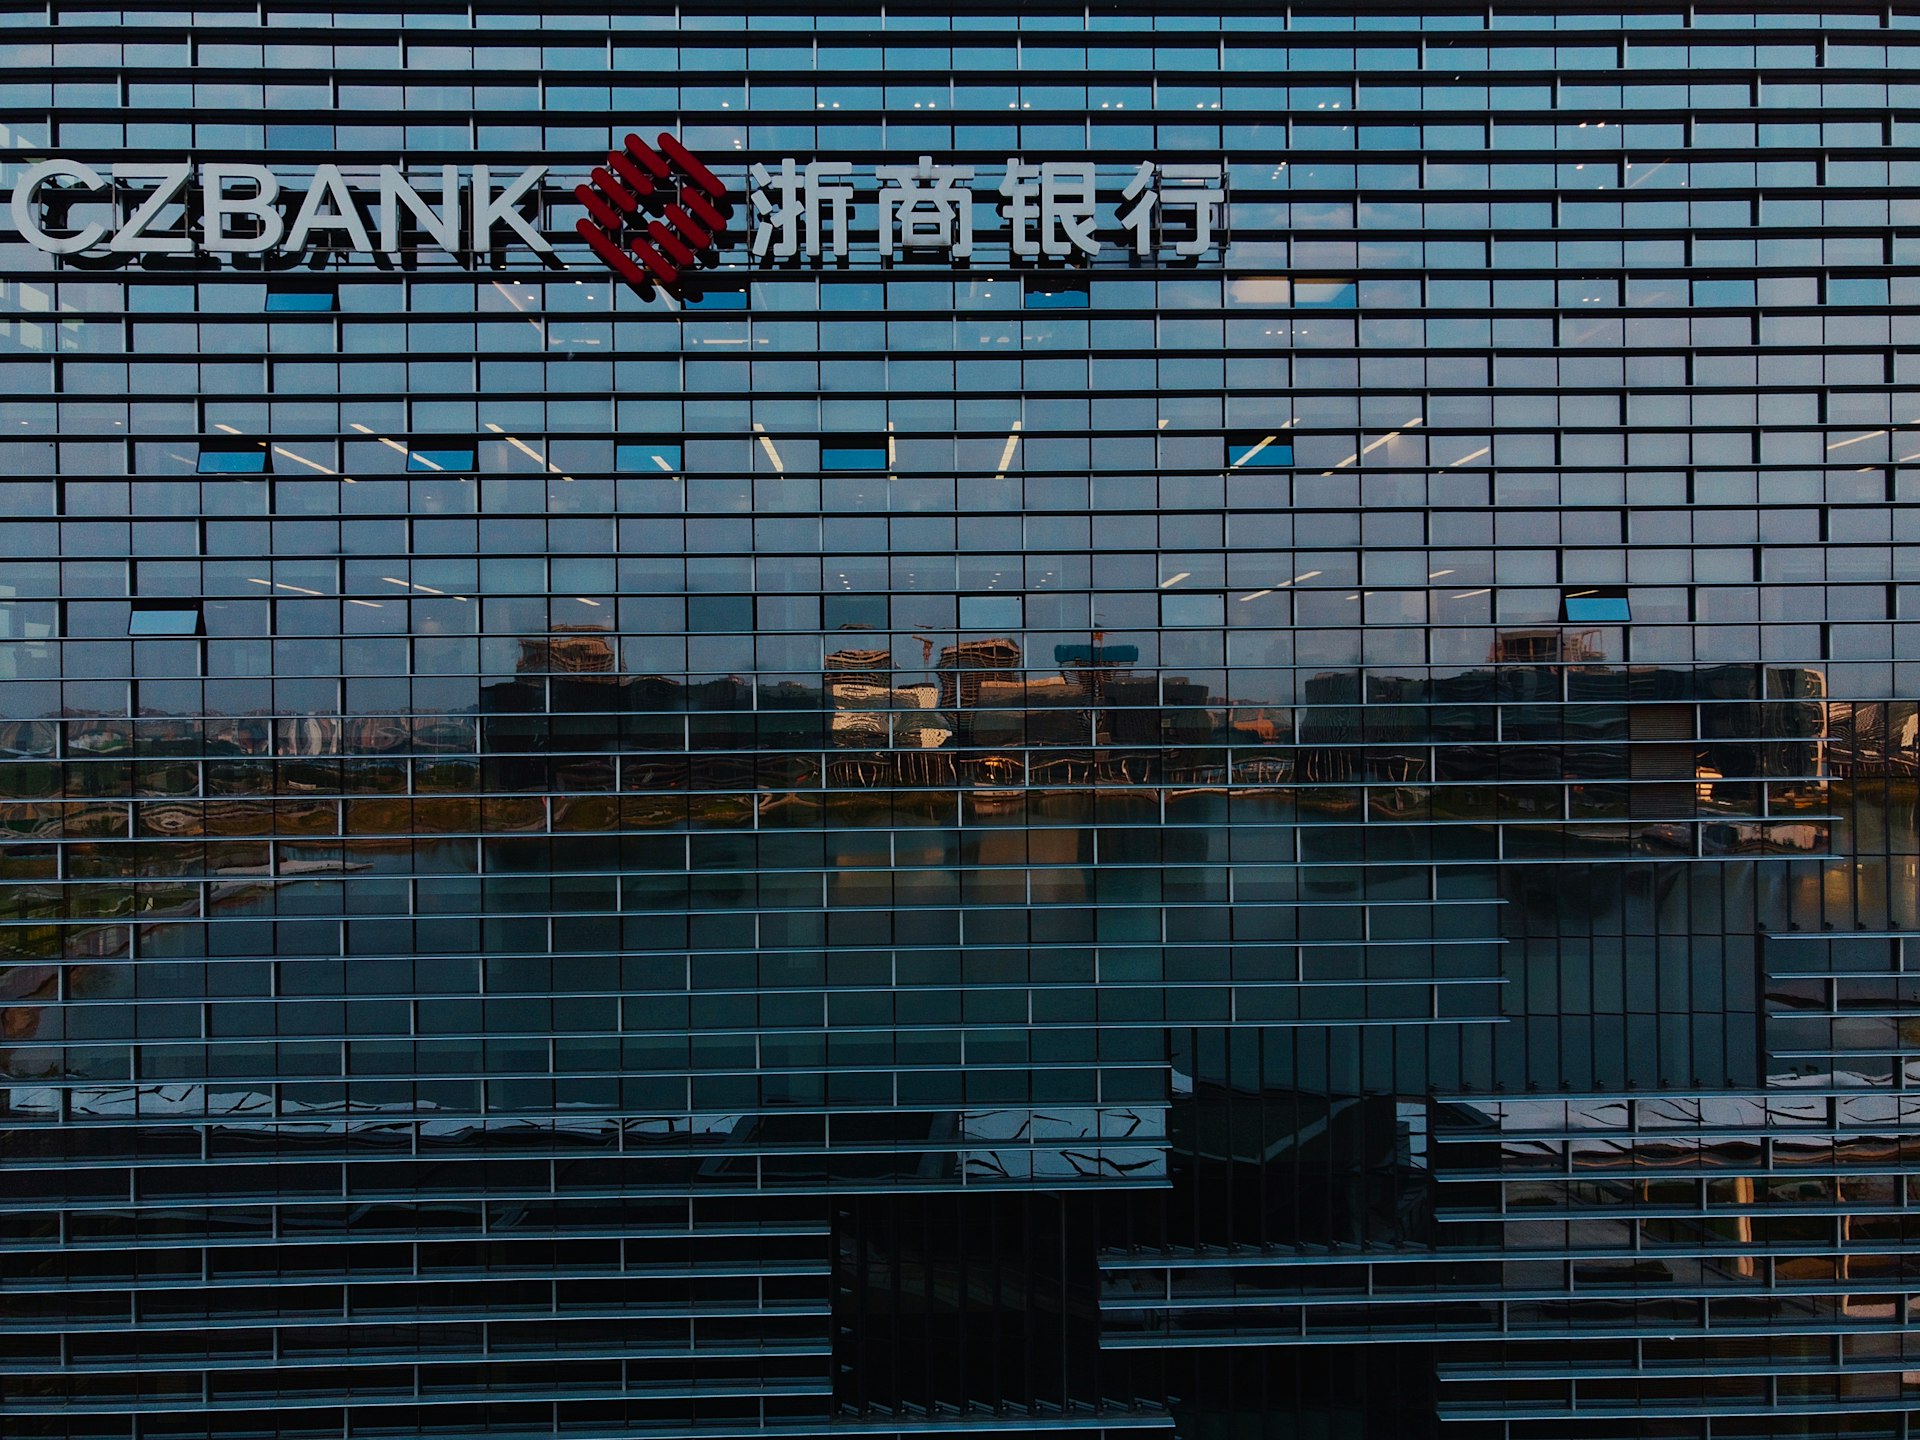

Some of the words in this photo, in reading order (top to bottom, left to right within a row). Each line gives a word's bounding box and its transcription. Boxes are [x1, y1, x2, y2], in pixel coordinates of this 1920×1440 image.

[11, 158, 555, 255] CZBANK
[750, 156, 1225, 258] 浙商银行
